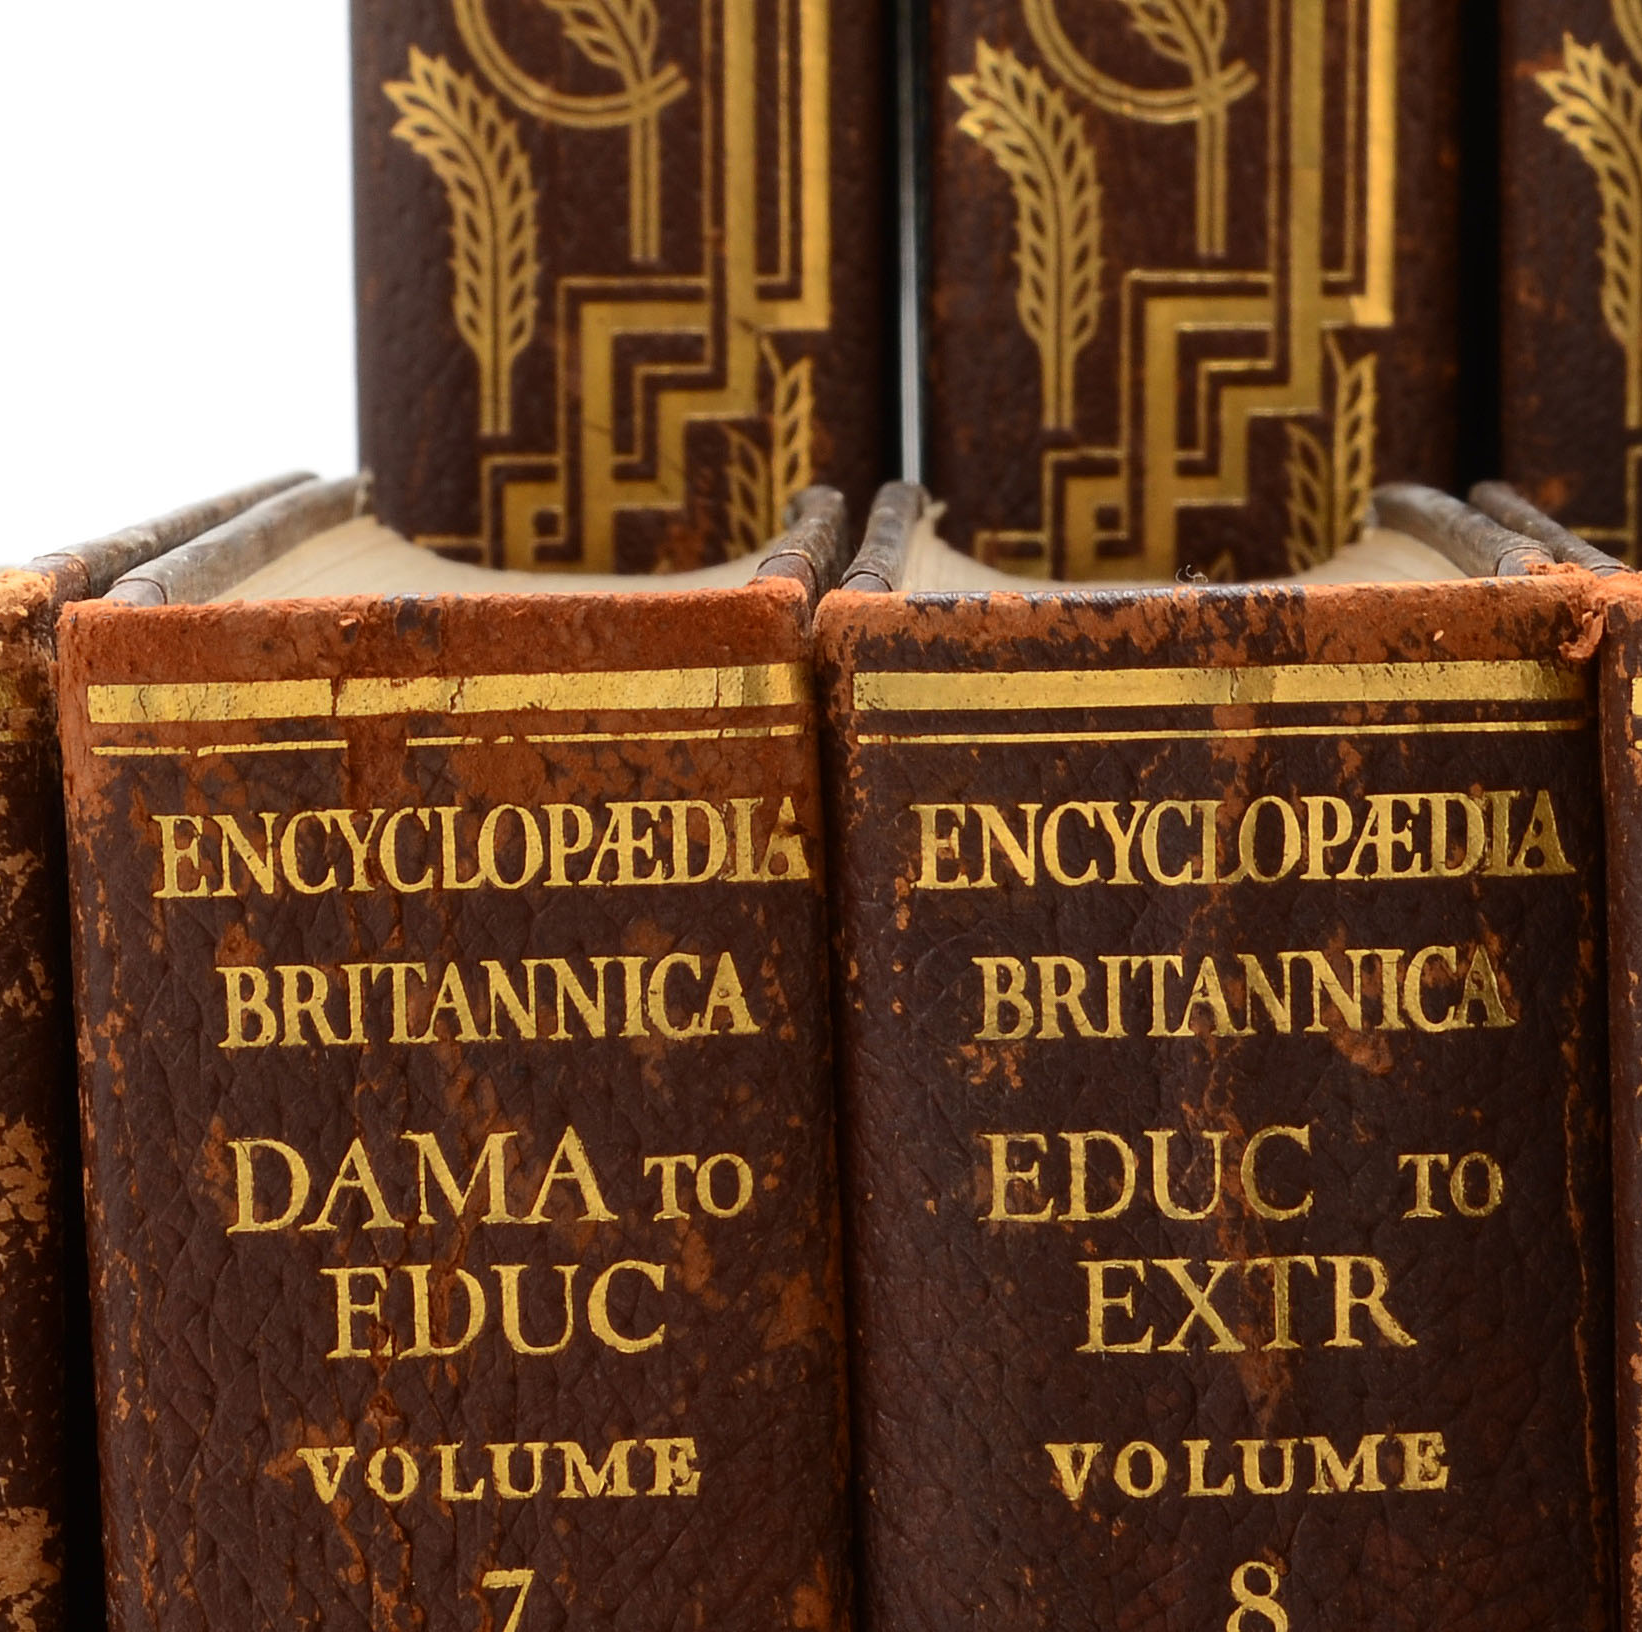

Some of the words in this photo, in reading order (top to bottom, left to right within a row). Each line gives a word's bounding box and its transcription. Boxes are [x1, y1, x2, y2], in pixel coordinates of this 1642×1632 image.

[151, 795, 810, 899] ENCYCLOPÆDIA
[910, 791, 1575, 890] ENCYCLOPÆDIA
[216, 951, 759, 1049] BRITANNICA
[973, 945, 1517, 1041] BRITANNICA
[225, 1125, 618, 1233] DAMA
[643, 1153, 754, 1222] TO
[978, 1126, 1313, 1223] EDUC
[1399, 1150, 1504, 1219] TO
[321, 1261, 667, 1360] EDUC
[1075, 1255, 1418, 1355] EXTR
[297, 1437, 702, 1503] VOLUME
[1045, 1432, 1449, 1500] VOLUME
